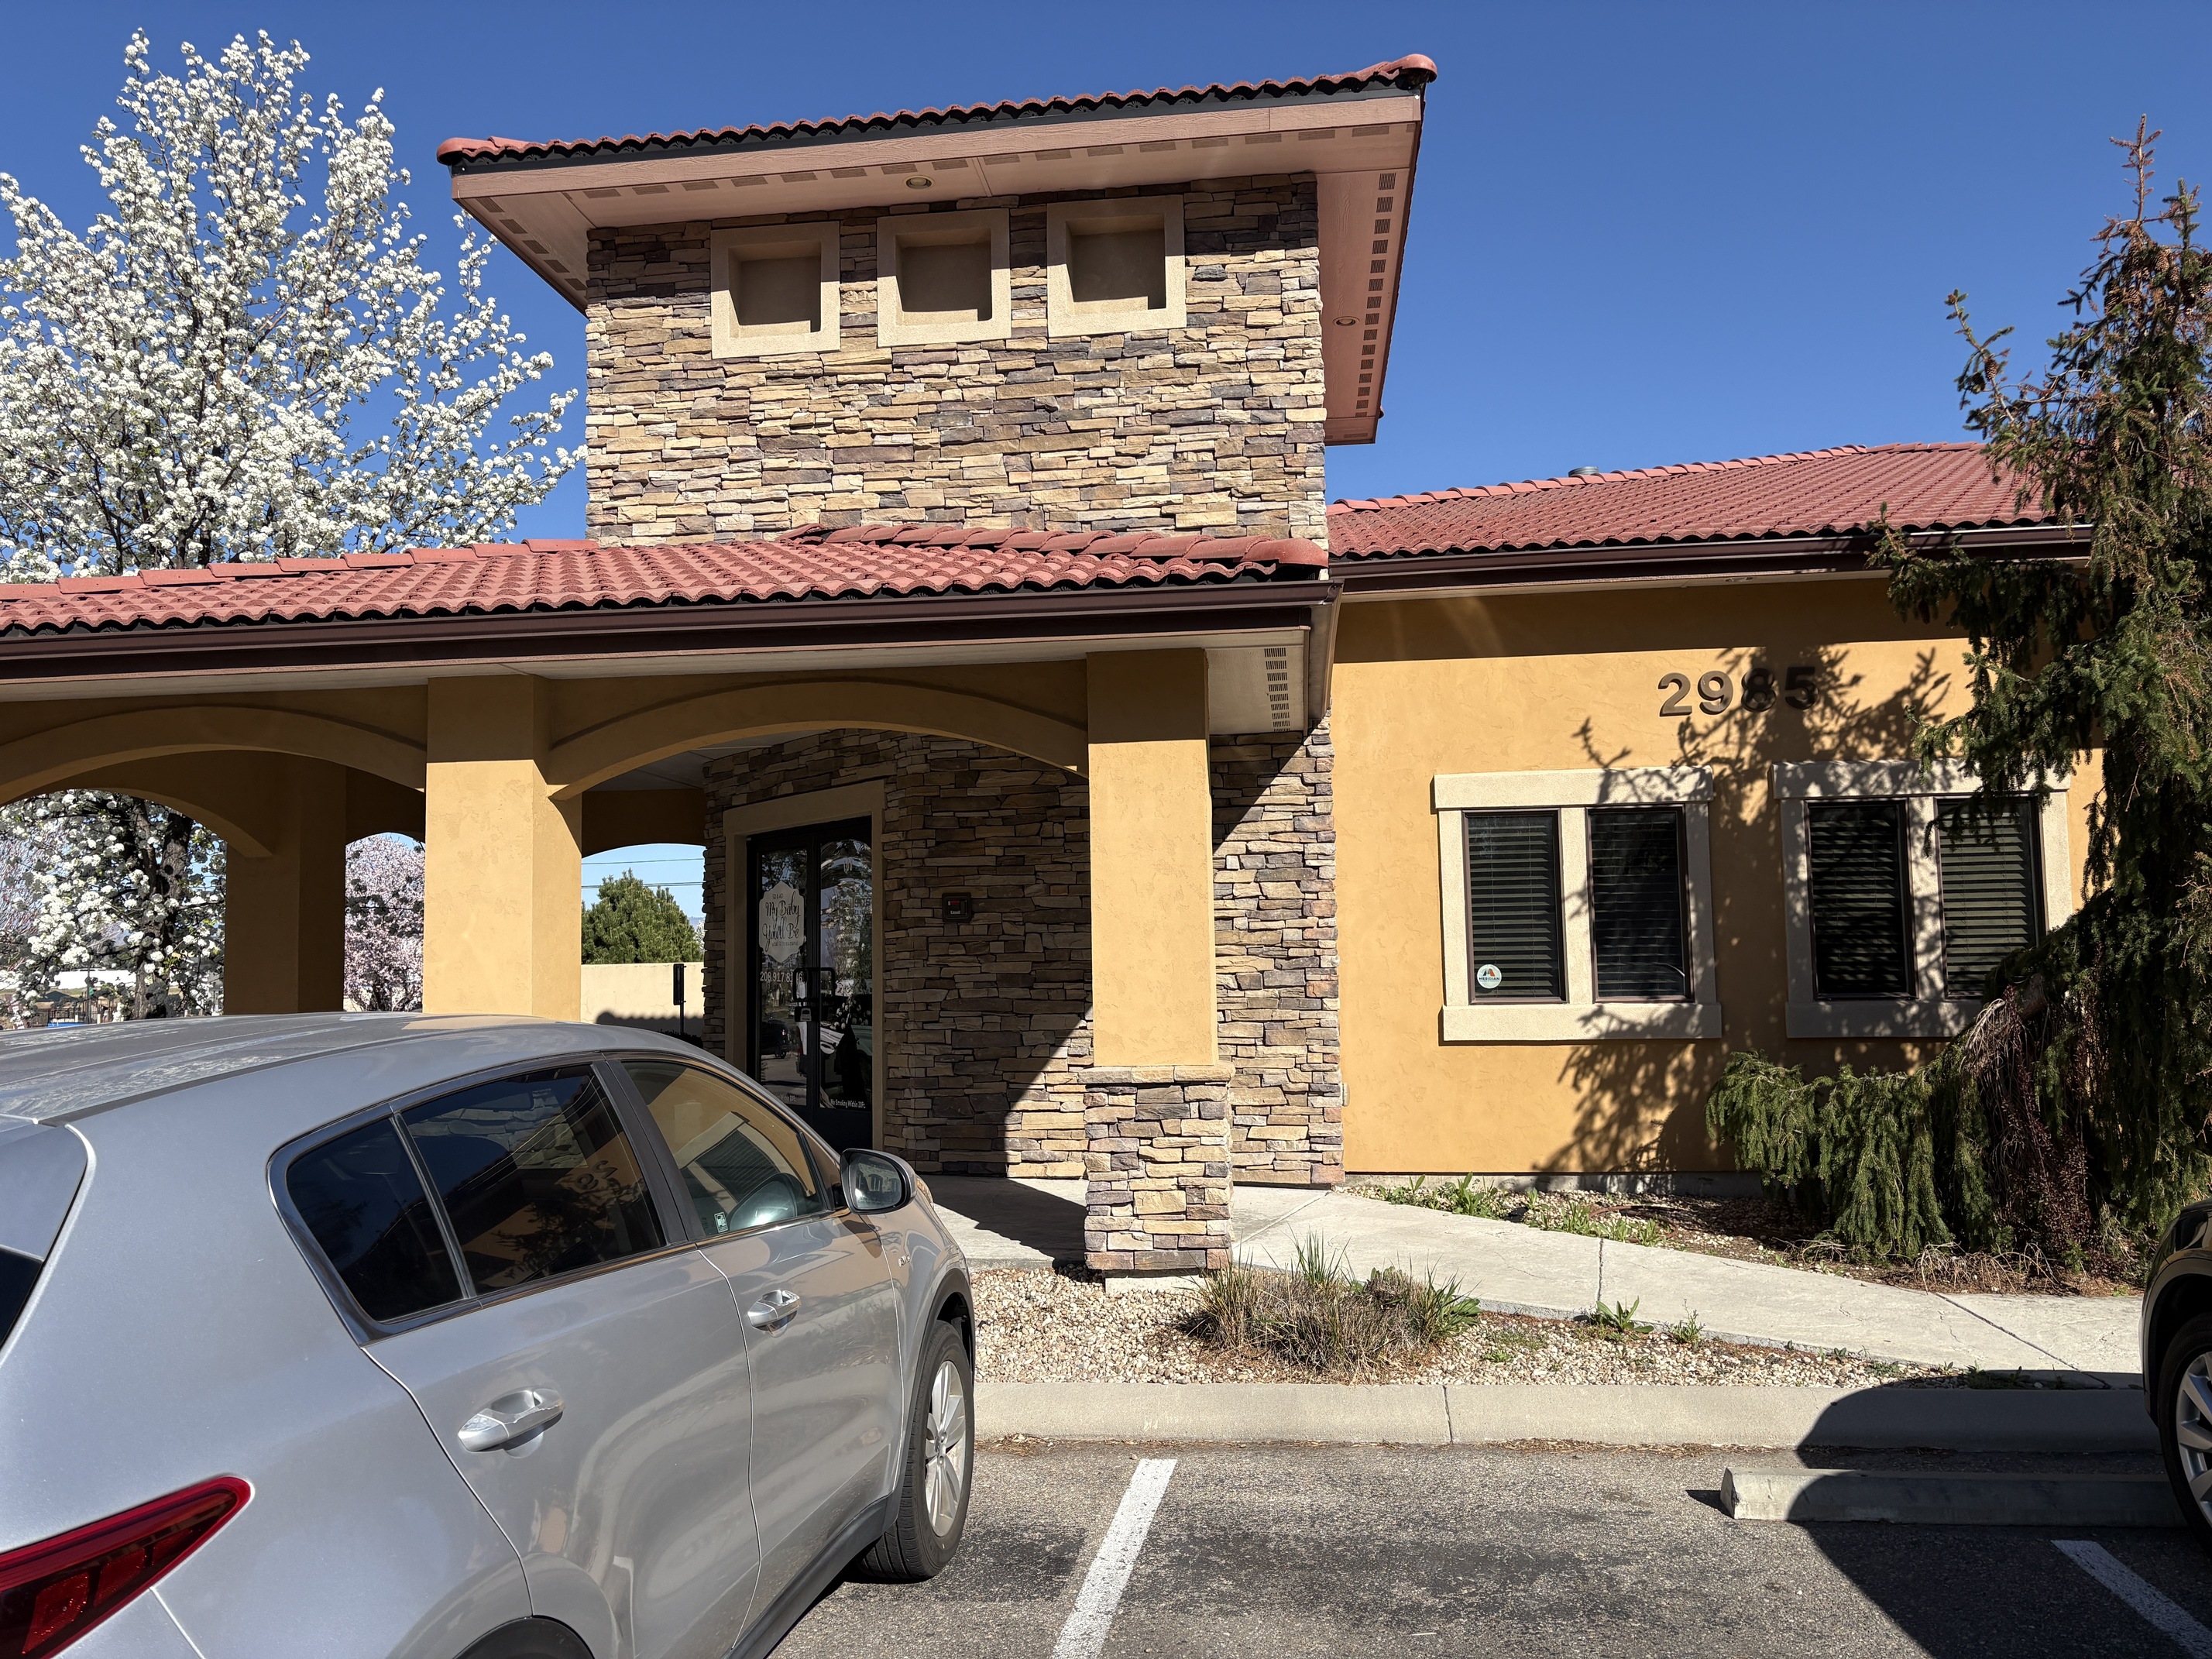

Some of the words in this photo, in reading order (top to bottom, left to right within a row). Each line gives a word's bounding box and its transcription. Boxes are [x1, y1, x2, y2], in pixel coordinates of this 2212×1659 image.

[1657, 666, 1819, 717] 2985
[765, 902, 778, 929] My
[778, 891, 801, 929] Baby
[787, 922, 799, 939] Be
